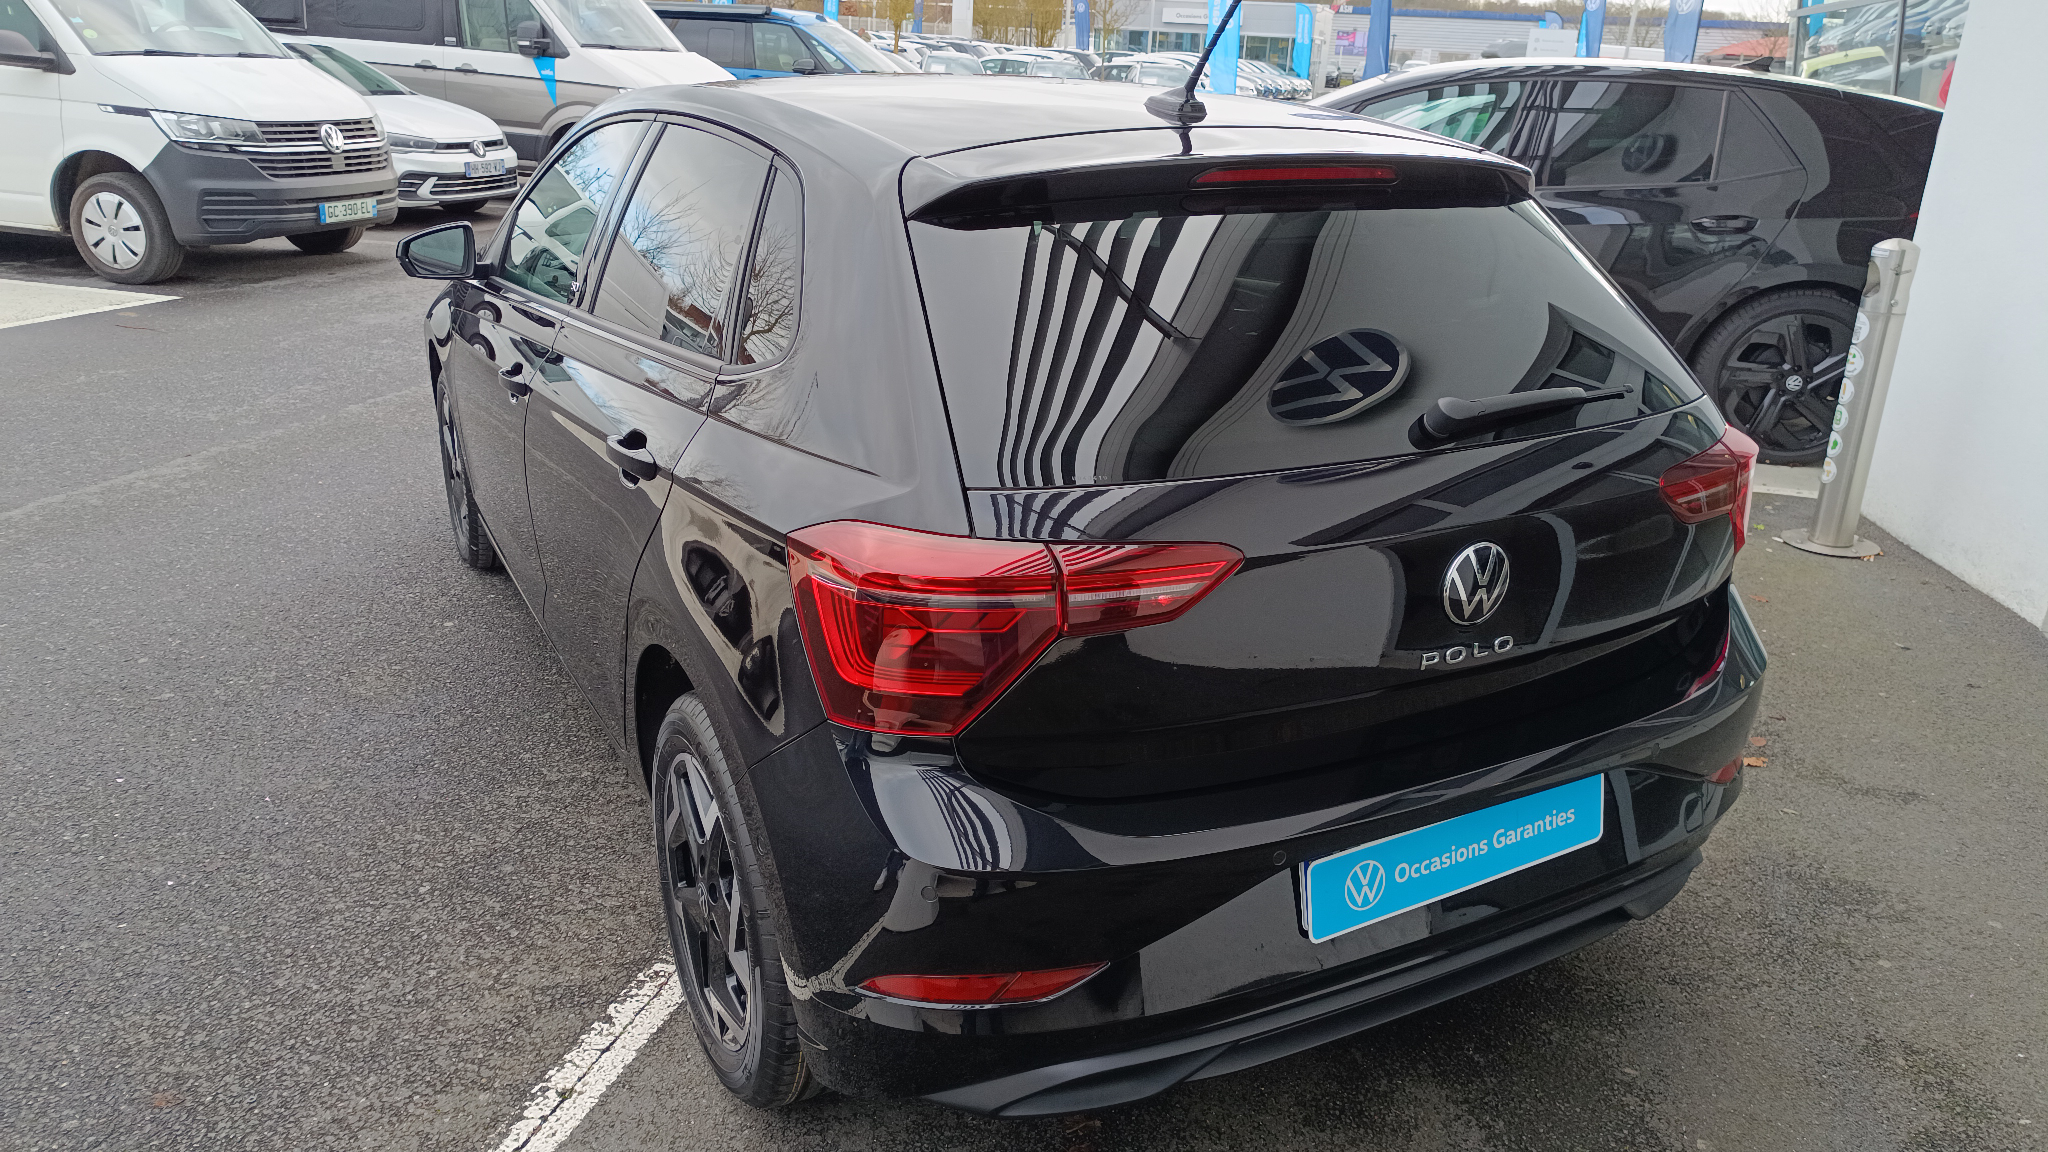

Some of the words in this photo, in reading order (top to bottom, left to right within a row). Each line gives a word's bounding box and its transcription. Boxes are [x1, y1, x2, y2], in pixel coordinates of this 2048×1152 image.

[327, 201, 371, 218] GC-390-EL
[1420, 635, 1514, 671] POLO
[1394, 837, 1488, 883] Occasions
[1492, 807, 1576, 849] Garanties
